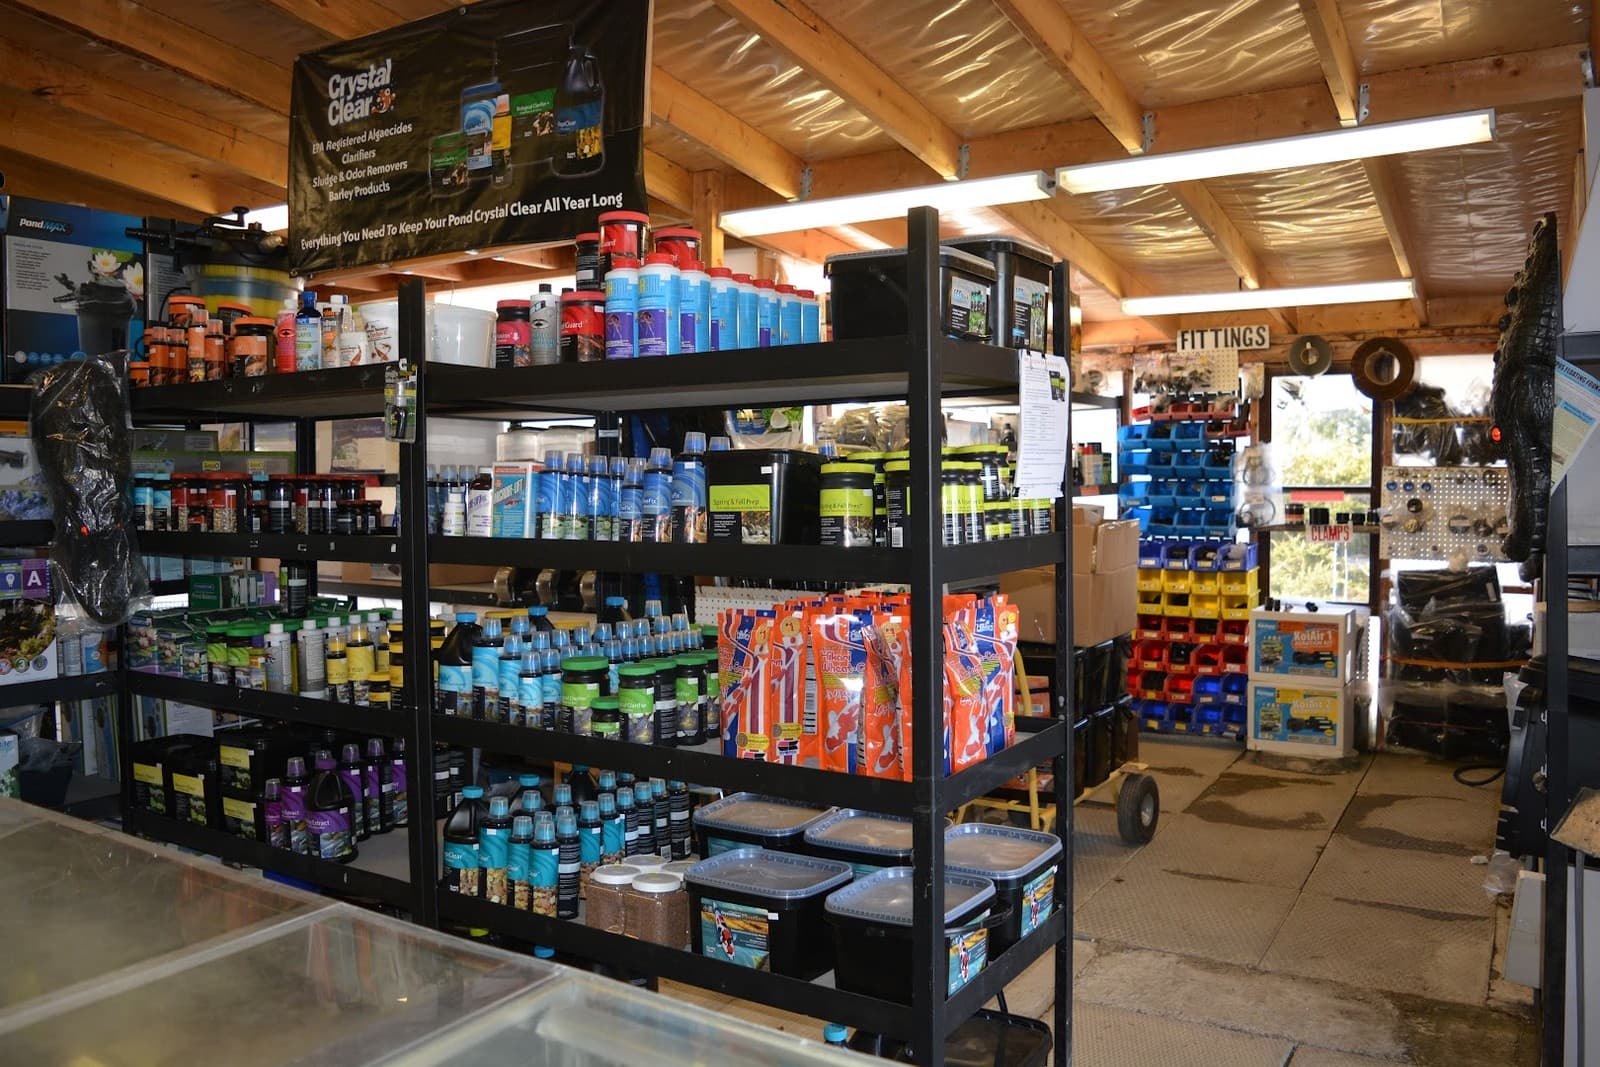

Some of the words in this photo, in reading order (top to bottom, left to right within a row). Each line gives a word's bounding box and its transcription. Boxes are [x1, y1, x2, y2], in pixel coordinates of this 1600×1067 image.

[328, 58, 392, 101] Crystal
[328, 96, 374, 127] Clear
[326, 131, 367, 152] Registered
[368, 122, 413, 142] Algaecides
[341, 148, 377, 165] Clarifiers
[312, 173, 338, 188] Sludge
[339, 171, 345, 183] &
[345, 167, 366, 182] Odor
[367, 160, 408, 178] Removers
[329, 187, 354, 202] Barley
[354, 180, 391, 198] Products
[301, 232, 342, 250] Everything
[343, 229, 361, 243] You
[362, 224, 386, 241] Need
[387, 223, 398, 236] To
[400, 219, 423, 235] Keep
[425, 214, 447, 230] Your
[448, 209, 473, 227] Pond
[474, 203, 509, 224] Crystal
[510, 200, 542, 216] Clear
[543, 196, 560, 213] All
[562, 194, 591, 210] Year
[592, 192, 623, 209] Long
[1181, 326, 1266, 350] FITTINGS
[1311, 524, 1350, 541] CLAMPS
